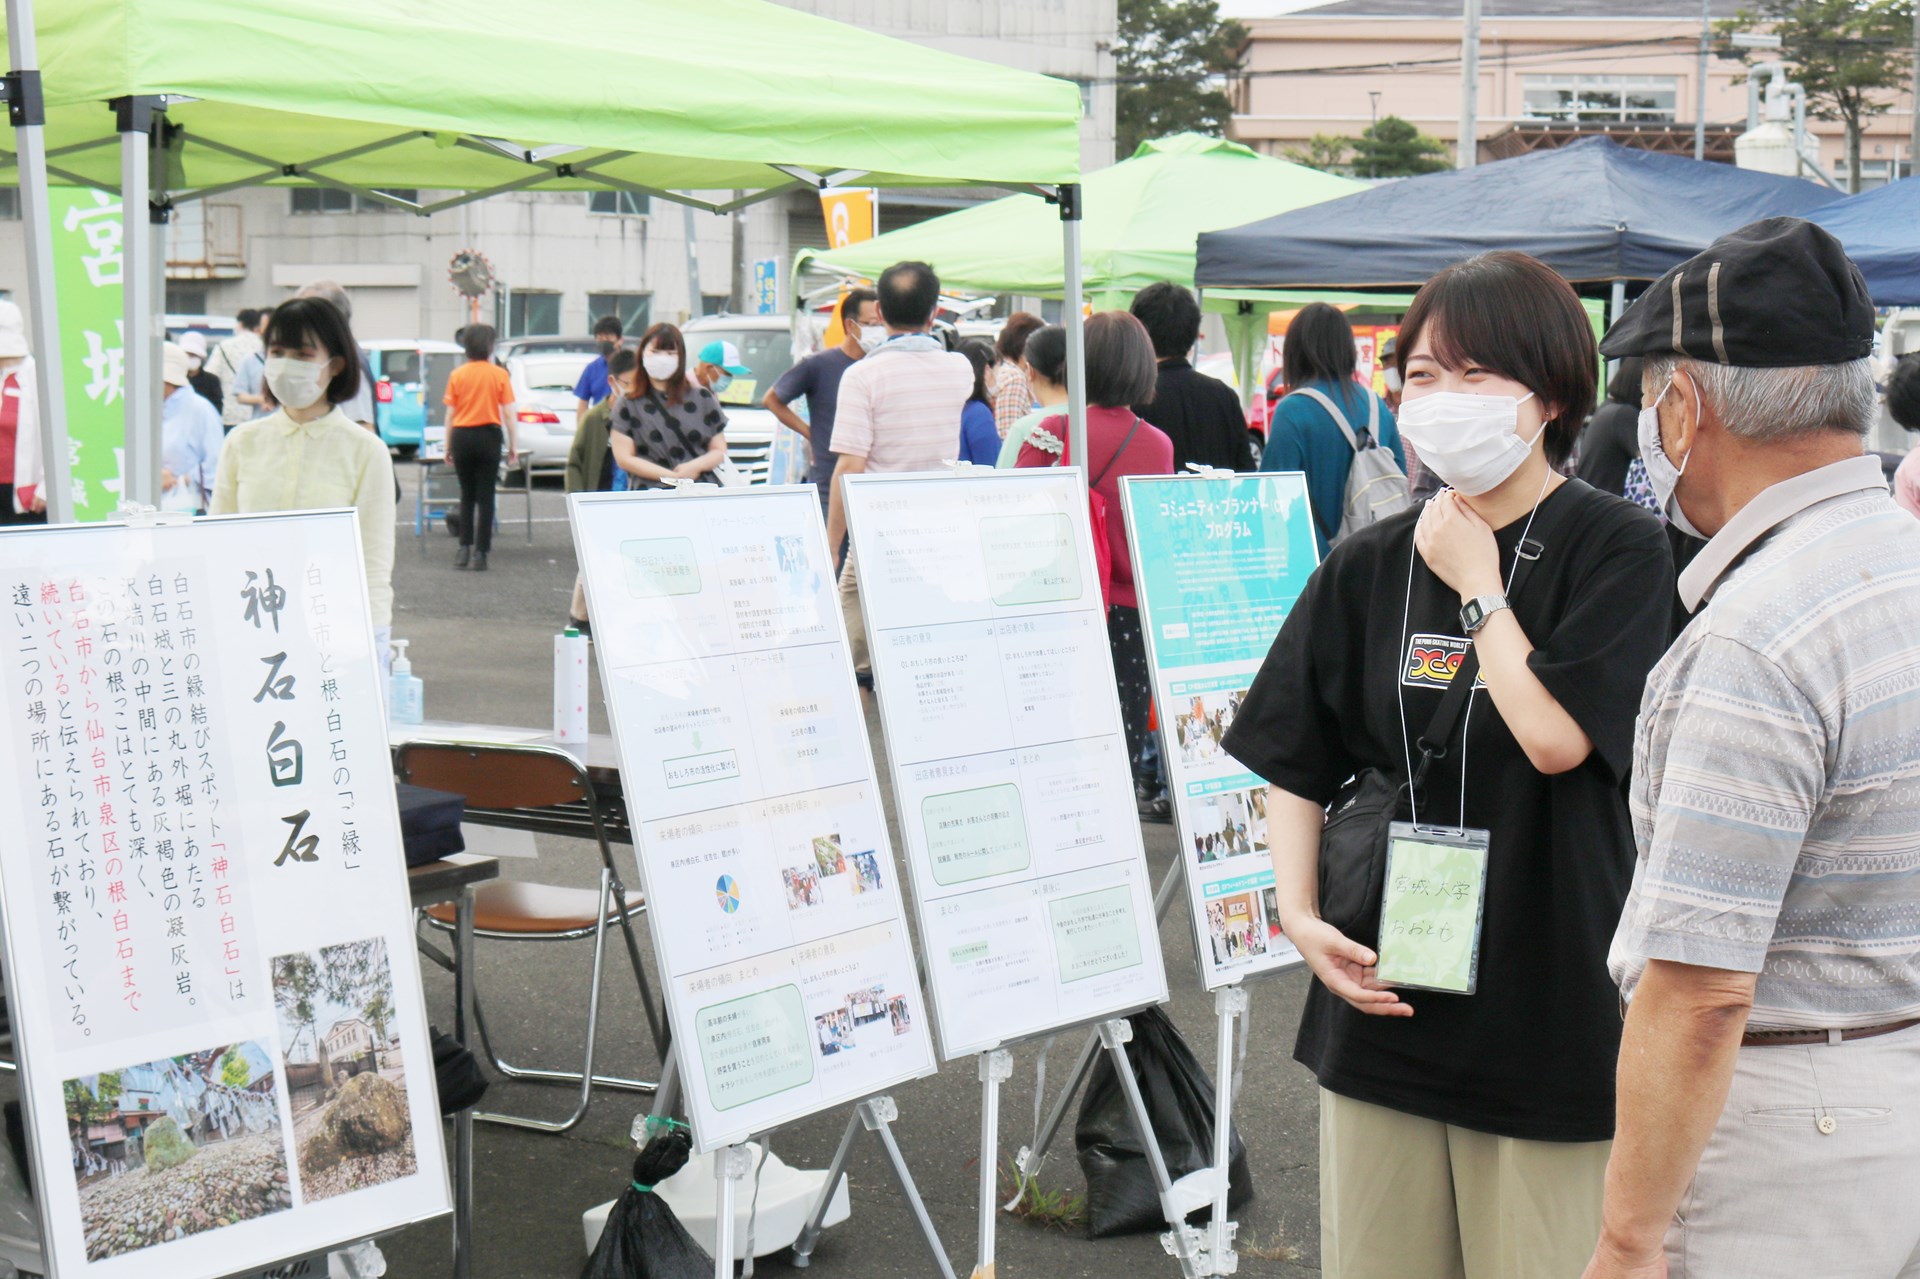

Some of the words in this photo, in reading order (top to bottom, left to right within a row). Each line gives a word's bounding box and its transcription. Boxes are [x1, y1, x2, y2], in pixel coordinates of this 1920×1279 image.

[1206, 521, 1252, 540] プログラム
[12, 582, 91, 1036] 遠い二つの場所にある石が繋がっている。
[40, 581, 103, 919] 続いていると伝えられており、
[68, 579, 142, 1012] 白石市から仙台市泉区の根白石まで
[96, 577, 155, 898] この石の根っこはとても深く、
[148, 574, 207, 909] 白石城と三の丸外堀にあたる
[173, 571, 246, 1001] 白石市の縁結びスポット「神石白石」は
[240, 567, 320, 868] 神石白石
[306, 562, 363, 872] 白石市と根白石の「ご縁」
[1023, 753, 1040, 765] まとめ
[738, 967, 760, 981] まとめ
[941, 903, 960, 916] まとめ
